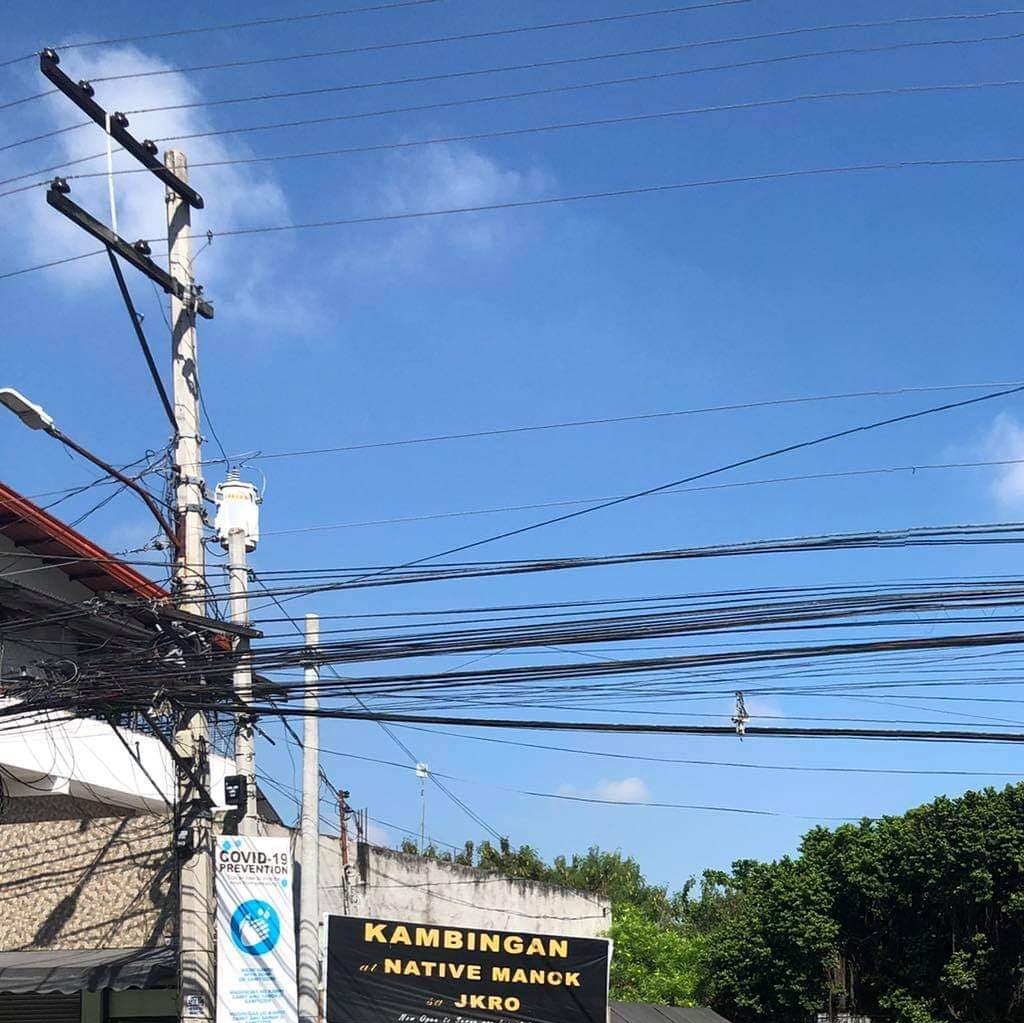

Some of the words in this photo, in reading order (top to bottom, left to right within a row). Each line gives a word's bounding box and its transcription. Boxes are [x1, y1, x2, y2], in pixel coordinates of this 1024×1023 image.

[219, 850, 288, 865] COVID-19
[219, 863, 288, 874] PREVENTION
[363, 922, 569, 958] KAMBINGAN
[384, 958, 482, 981] NATIVE
[491, 966, 582, 987] MANOK
[453, 994, 521, 1012] JKRO
